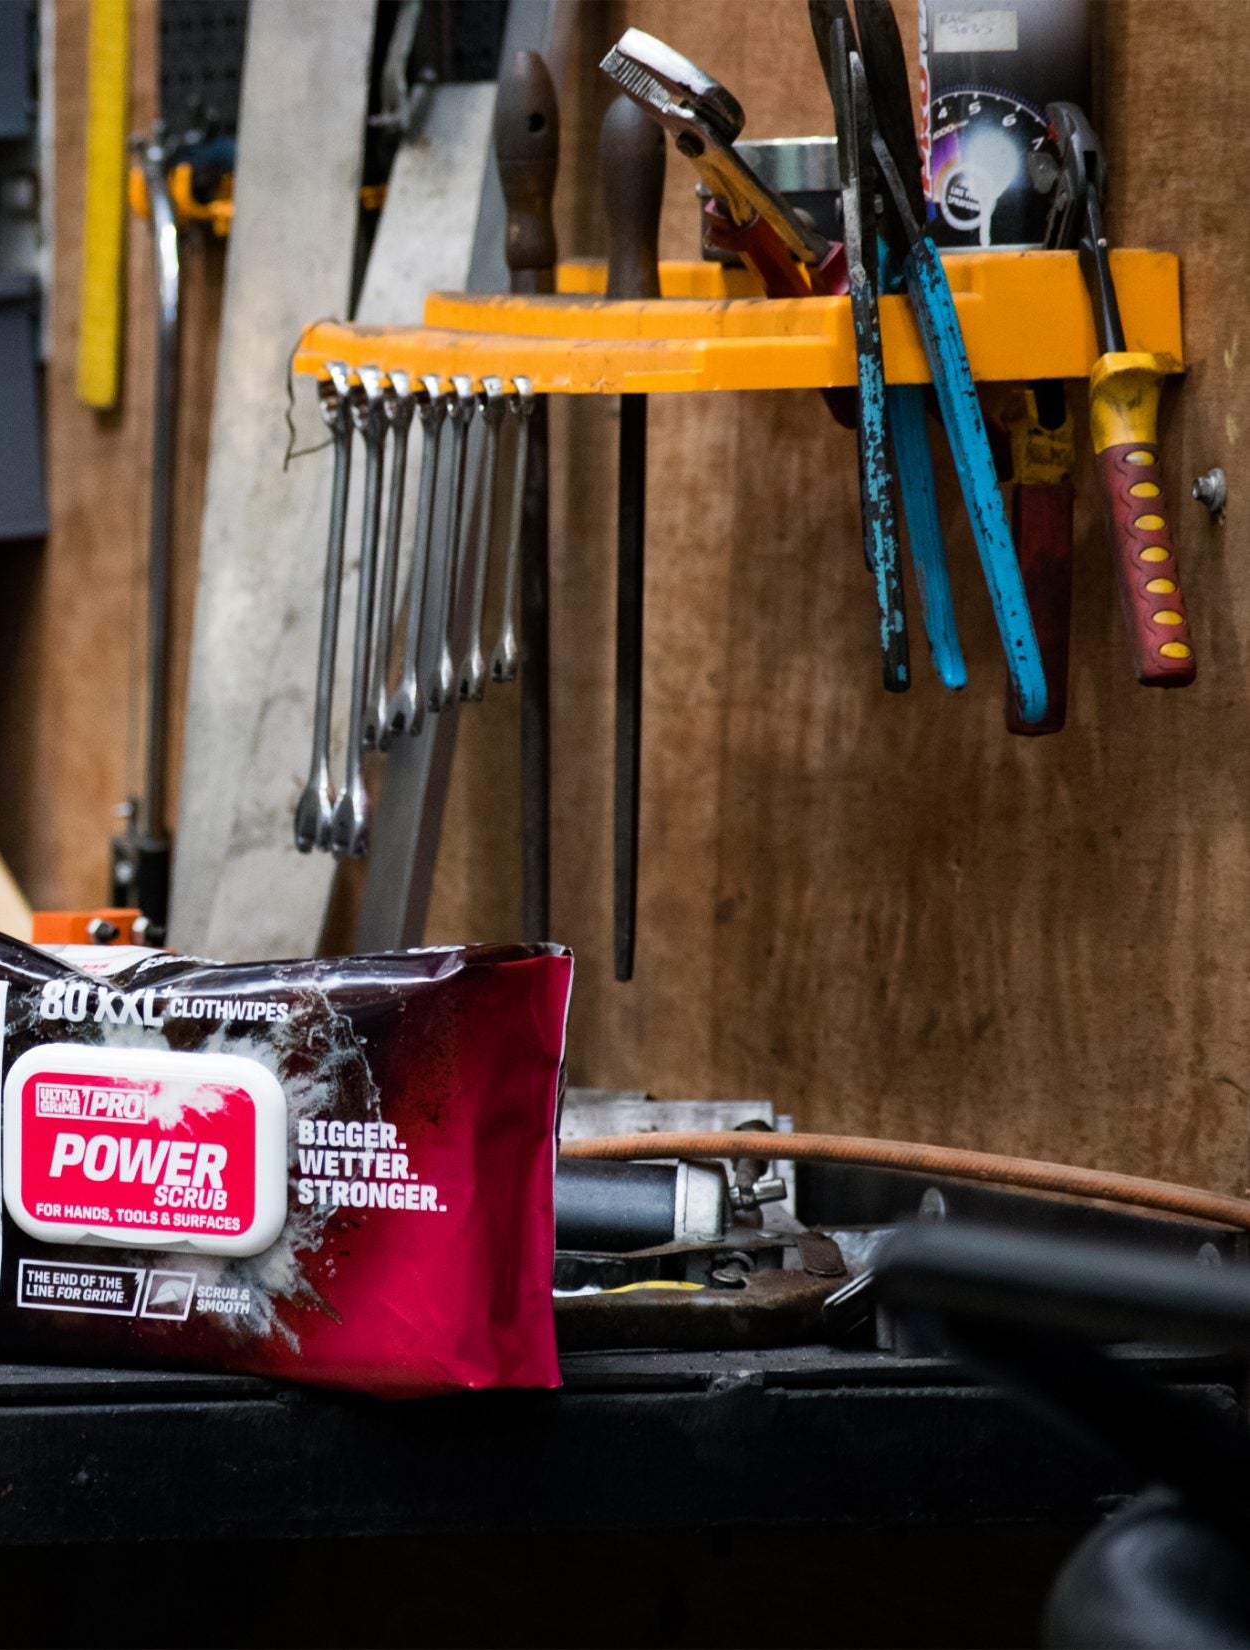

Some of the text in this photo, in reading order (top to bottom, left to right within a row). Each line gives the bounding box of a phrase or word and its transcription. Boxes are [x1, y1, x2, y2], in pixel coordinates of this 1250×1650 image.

[937, 101, 1045, 151] 4 5 6 7
[39, 979, 89, 1022] 80
[169, 998, 289, 1023] CLOTHWIPES
[39, 1087, 78, 1101] ULTRA
[40, 1100, 80, 1115] GRIME
[90, 1091, 144, 1119] PRO
[298, 1119, 407, 1150] BIGGER.
[49, 1132, 228, 1189] POWER
[298, 1149, 419, 1181] WETTER.
[153, 1185, 228, 1211] SCRUB
[298, 1178, 448, 1212] STRONGER.
[36, 1202, 241, 1231] FOR HANDS, TOOLS & SURFACES
[26, 1284, 125, 1303] LINE FOR GRIME
[27, 1270, 123, 1290] THE END OF THE
[196, 1285, 250, 1300] SCRUB &
[196, 1300, 251, 1315] SMOOTH
